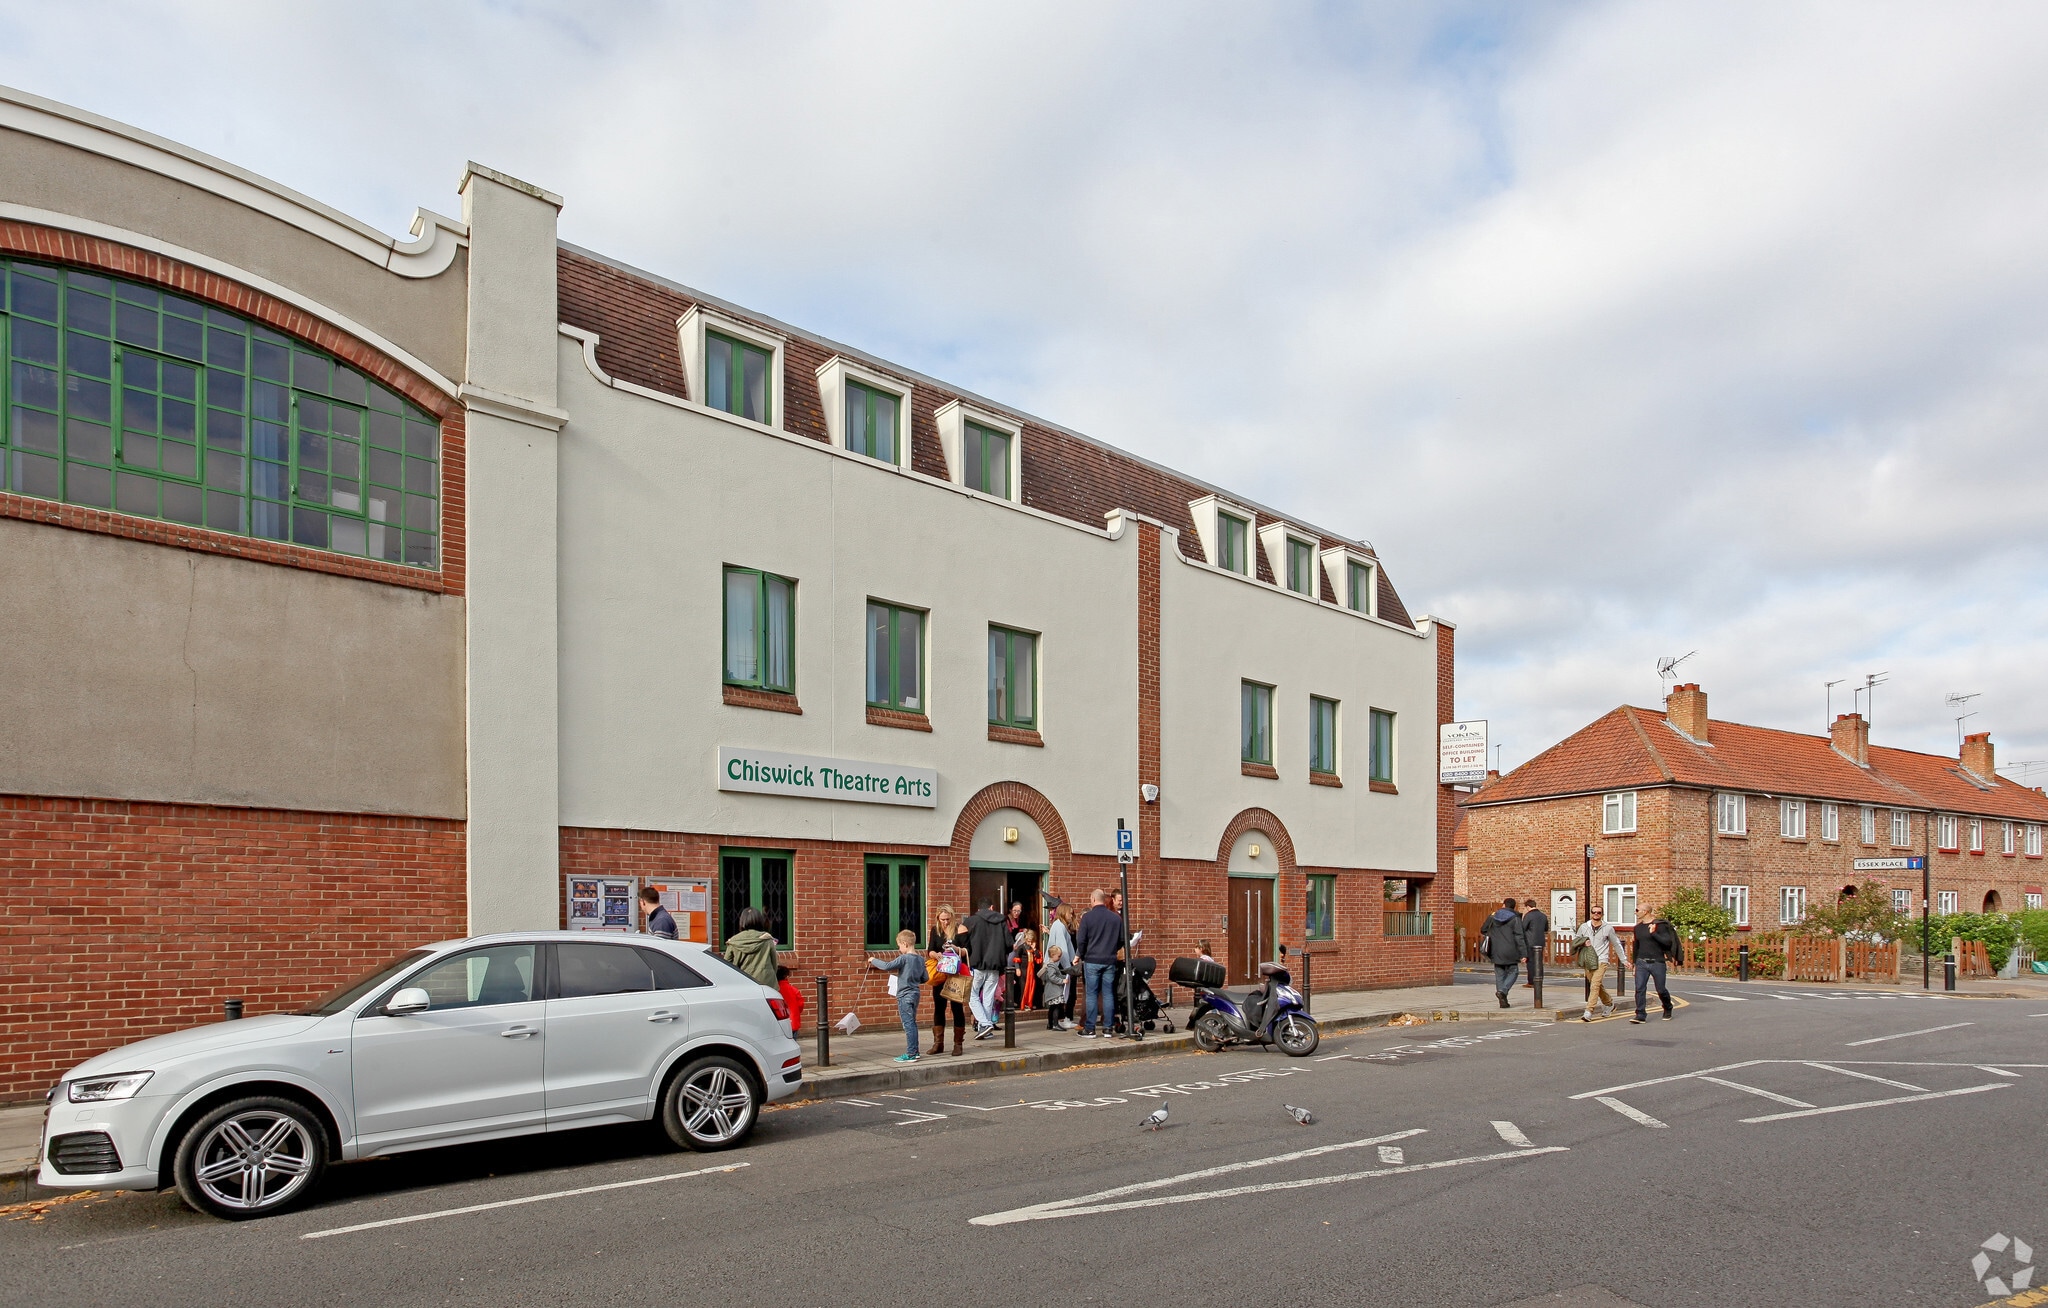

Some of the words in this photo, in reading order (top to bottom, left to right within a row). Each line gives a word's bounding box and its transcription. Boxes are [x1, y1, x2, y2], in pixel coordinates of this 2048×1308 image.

[727, 758, 815, 787] Chiswick
[819, 767, 890, 794] Theatre
[895, 776, 931, 797] Arts
[1120, 831, 1131, 849] P
